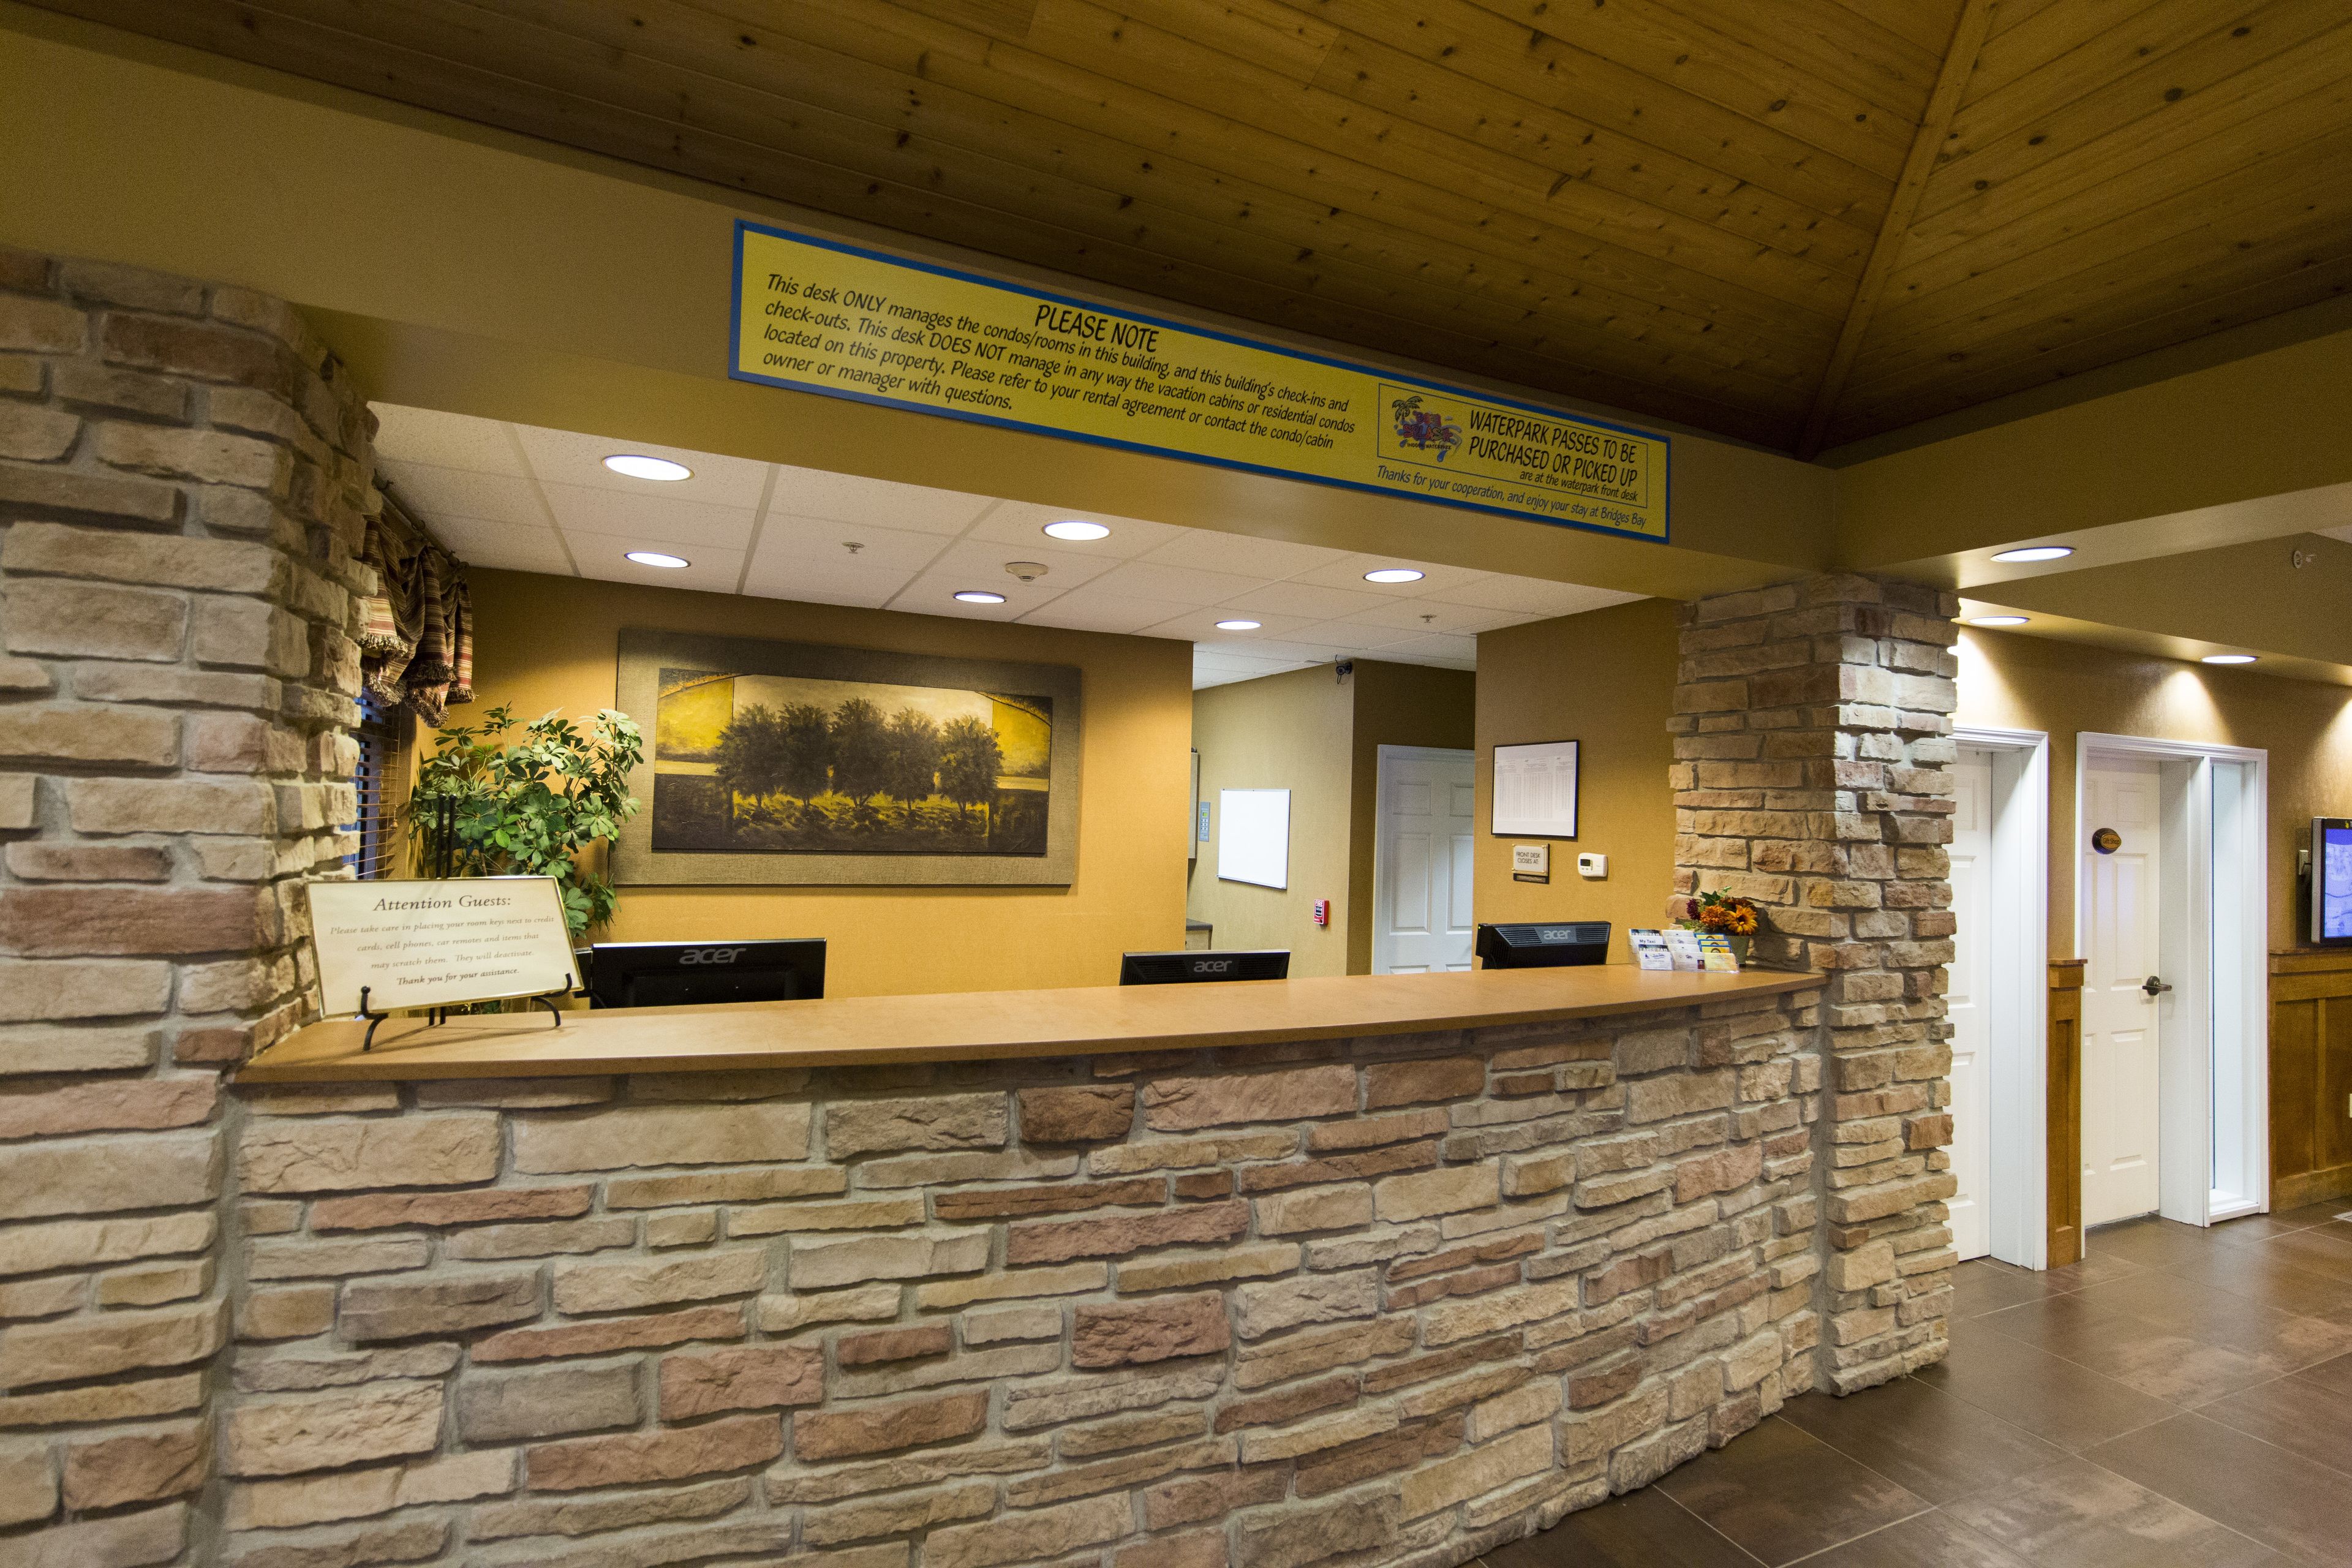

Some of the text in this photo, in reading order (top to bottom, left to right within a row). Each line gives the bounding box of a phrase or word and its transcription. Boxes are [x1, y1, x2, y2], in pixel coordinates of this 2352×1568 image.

[767, 273, 1349, 412] This desk ONLY manages the condos/rooms in this building, and this building's check-ins and
[1035, 304, 1159, 353] PLEASE NOTE
[763, 352, 1012, 410] owner or manager with questions.
[764, 300, 1355, 433] check-outs. This desk DOES NOT manage in any way the vacation cabins or residential condos
[764, 323, 1333, 448] located on this property. Please refer to your rental agreement or contact the condo/cabin
[1470, 410, 1637, 464] WATERPARK PASSES TO BE
[1468, 435, 1638, 488] PURCHASED OR PICKED UP
[1378, 465, 1646, 529] Thanks for your cooperation, and enjoy your stay at Bridges Bay
[1520, 470, 1638, 502] are at the waterpark front desk
[373, 895, 511, 911] Attention Guests:
[330, 926, 357, 935] Please
[360, 924, 379, 933] take
[413, 921, 444, 932] placing
[1543, 930, 1571, 940] acer
[385, 940, 401, 949] cell
[393, 957, 422, 967] scratch
[425, 956, 448, 965] them.
[476, 951, 491, 960] will
[679, 948, 747, 965] acer
[397, 974, 425, 986] Thank
[445, 972, 457, 982] for
[459, 972, 478, 981] your
[480, 968, 519, 977] assistance.
[1193, 960, 1232, 973] acer
